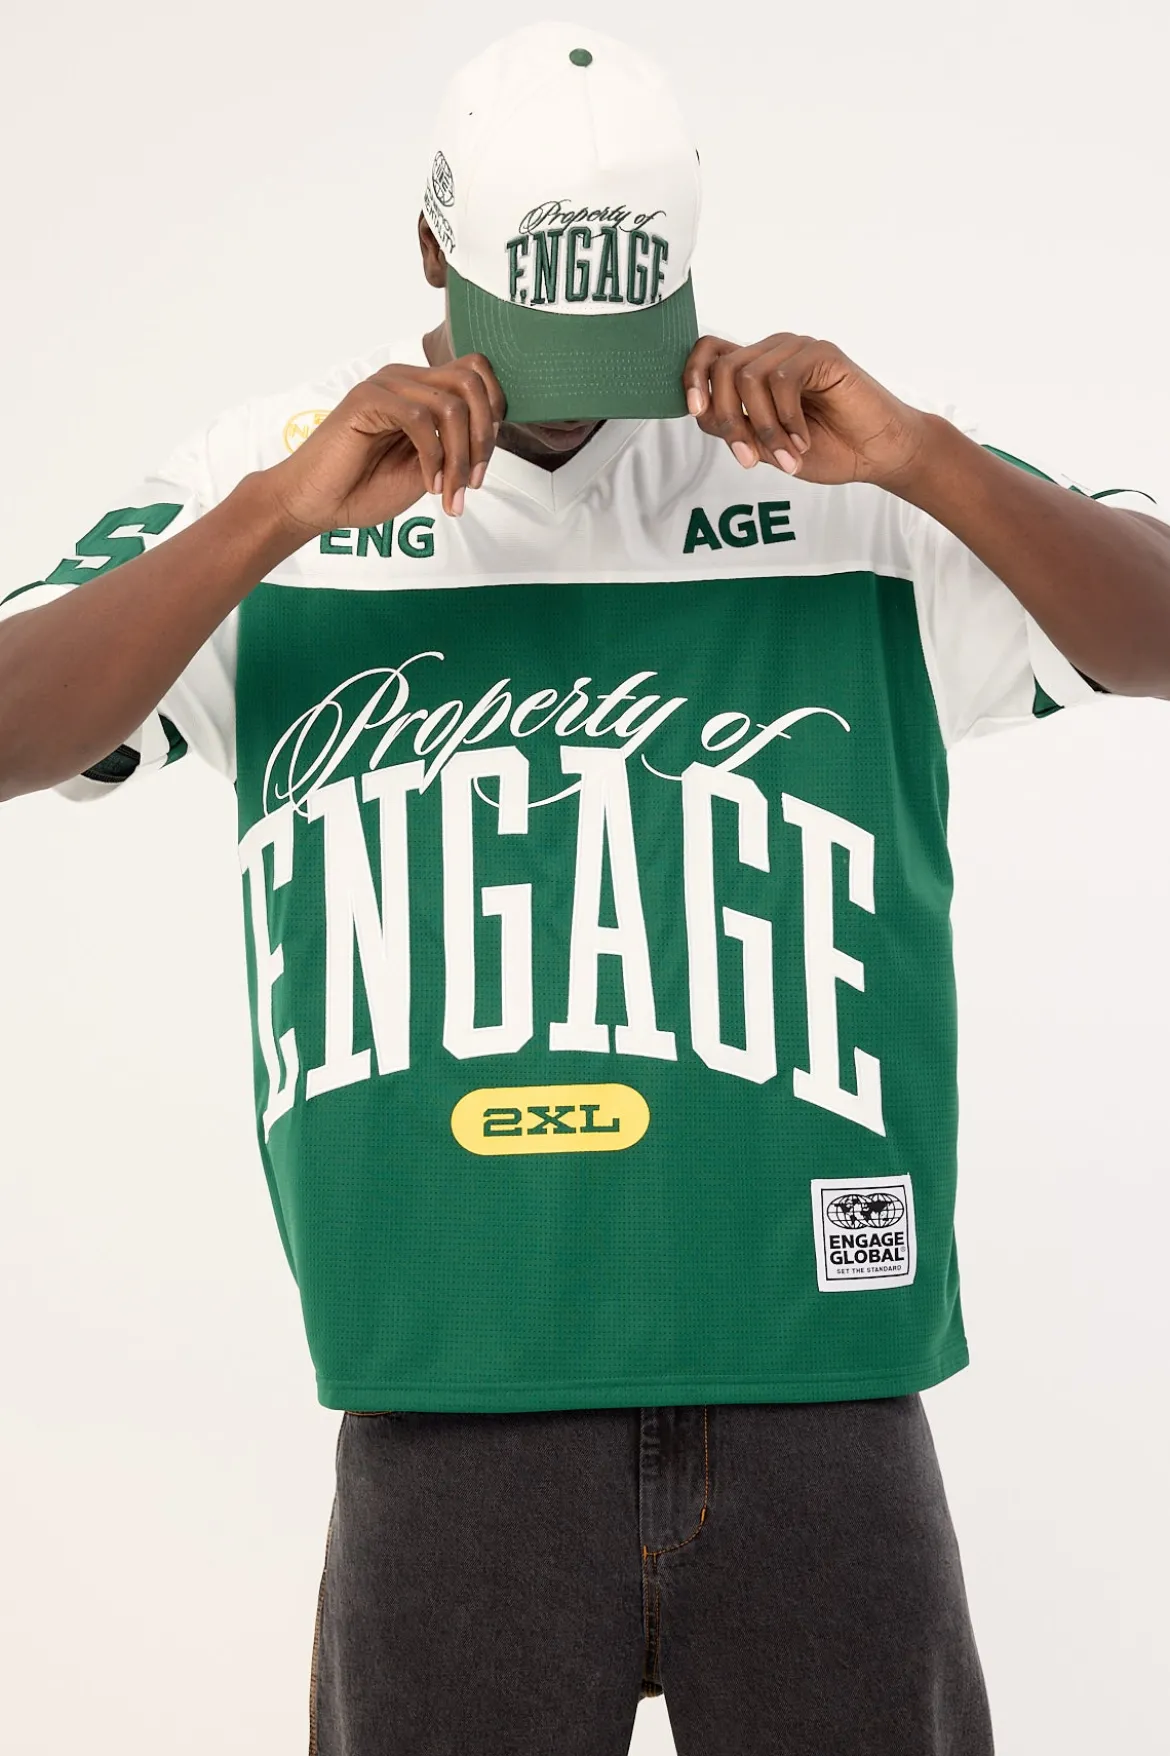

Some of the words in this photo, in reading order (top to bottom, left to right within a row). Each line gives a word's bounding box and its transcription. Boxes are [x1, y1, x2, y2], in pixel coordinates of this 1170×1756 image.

[518, 198, 632, 238] Property
[619, 210, 666, 232] of
[507, 226, 669, 306] ENGAGE
[320, 516, 435, 559] ENG
[683, 500, 796, 554] AGE
[263, 651, 688, 817] Property
[641, 706, 851, 780] of
[238, 746, 886, 1143] ENGAGE
[482, 1104, 621, 1138] 2XL
[829, 1232, 904, 1249] ENGAGE
[866, 1265, 902, 1273] STANDARD
